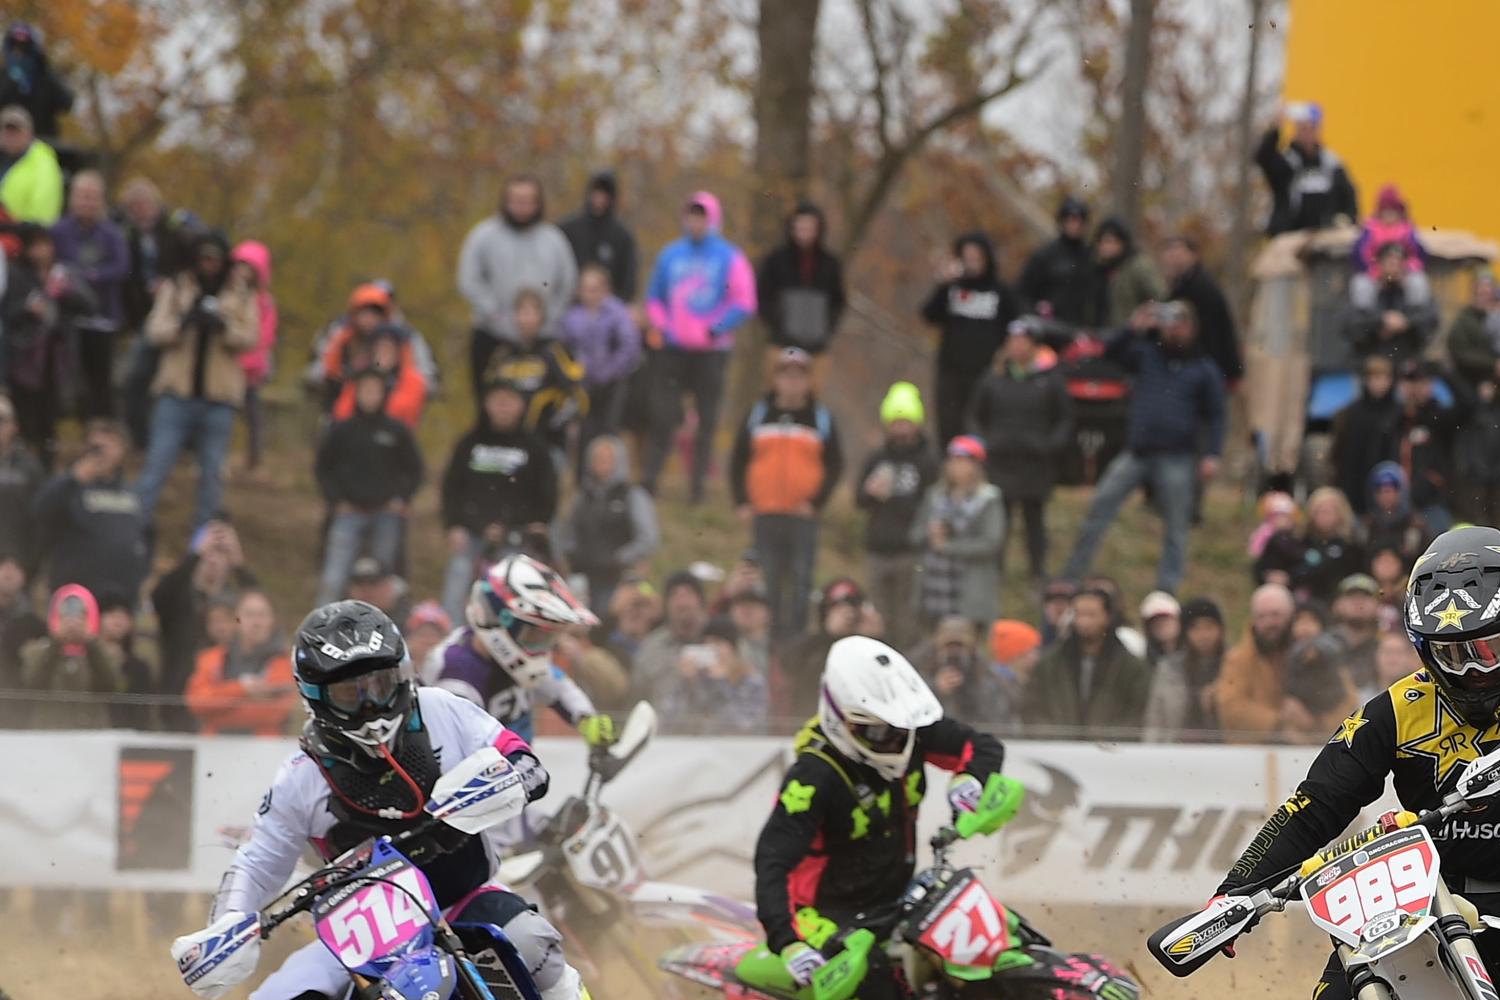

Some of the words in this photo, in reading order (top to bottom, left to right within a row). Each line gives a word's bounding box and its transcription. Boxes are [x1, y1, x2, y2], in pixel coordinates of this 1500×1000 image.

[328, 867, 434, 969] 514
[930, 882, 1002, 966] 27
[1324, 848, 1436, 940] 989
